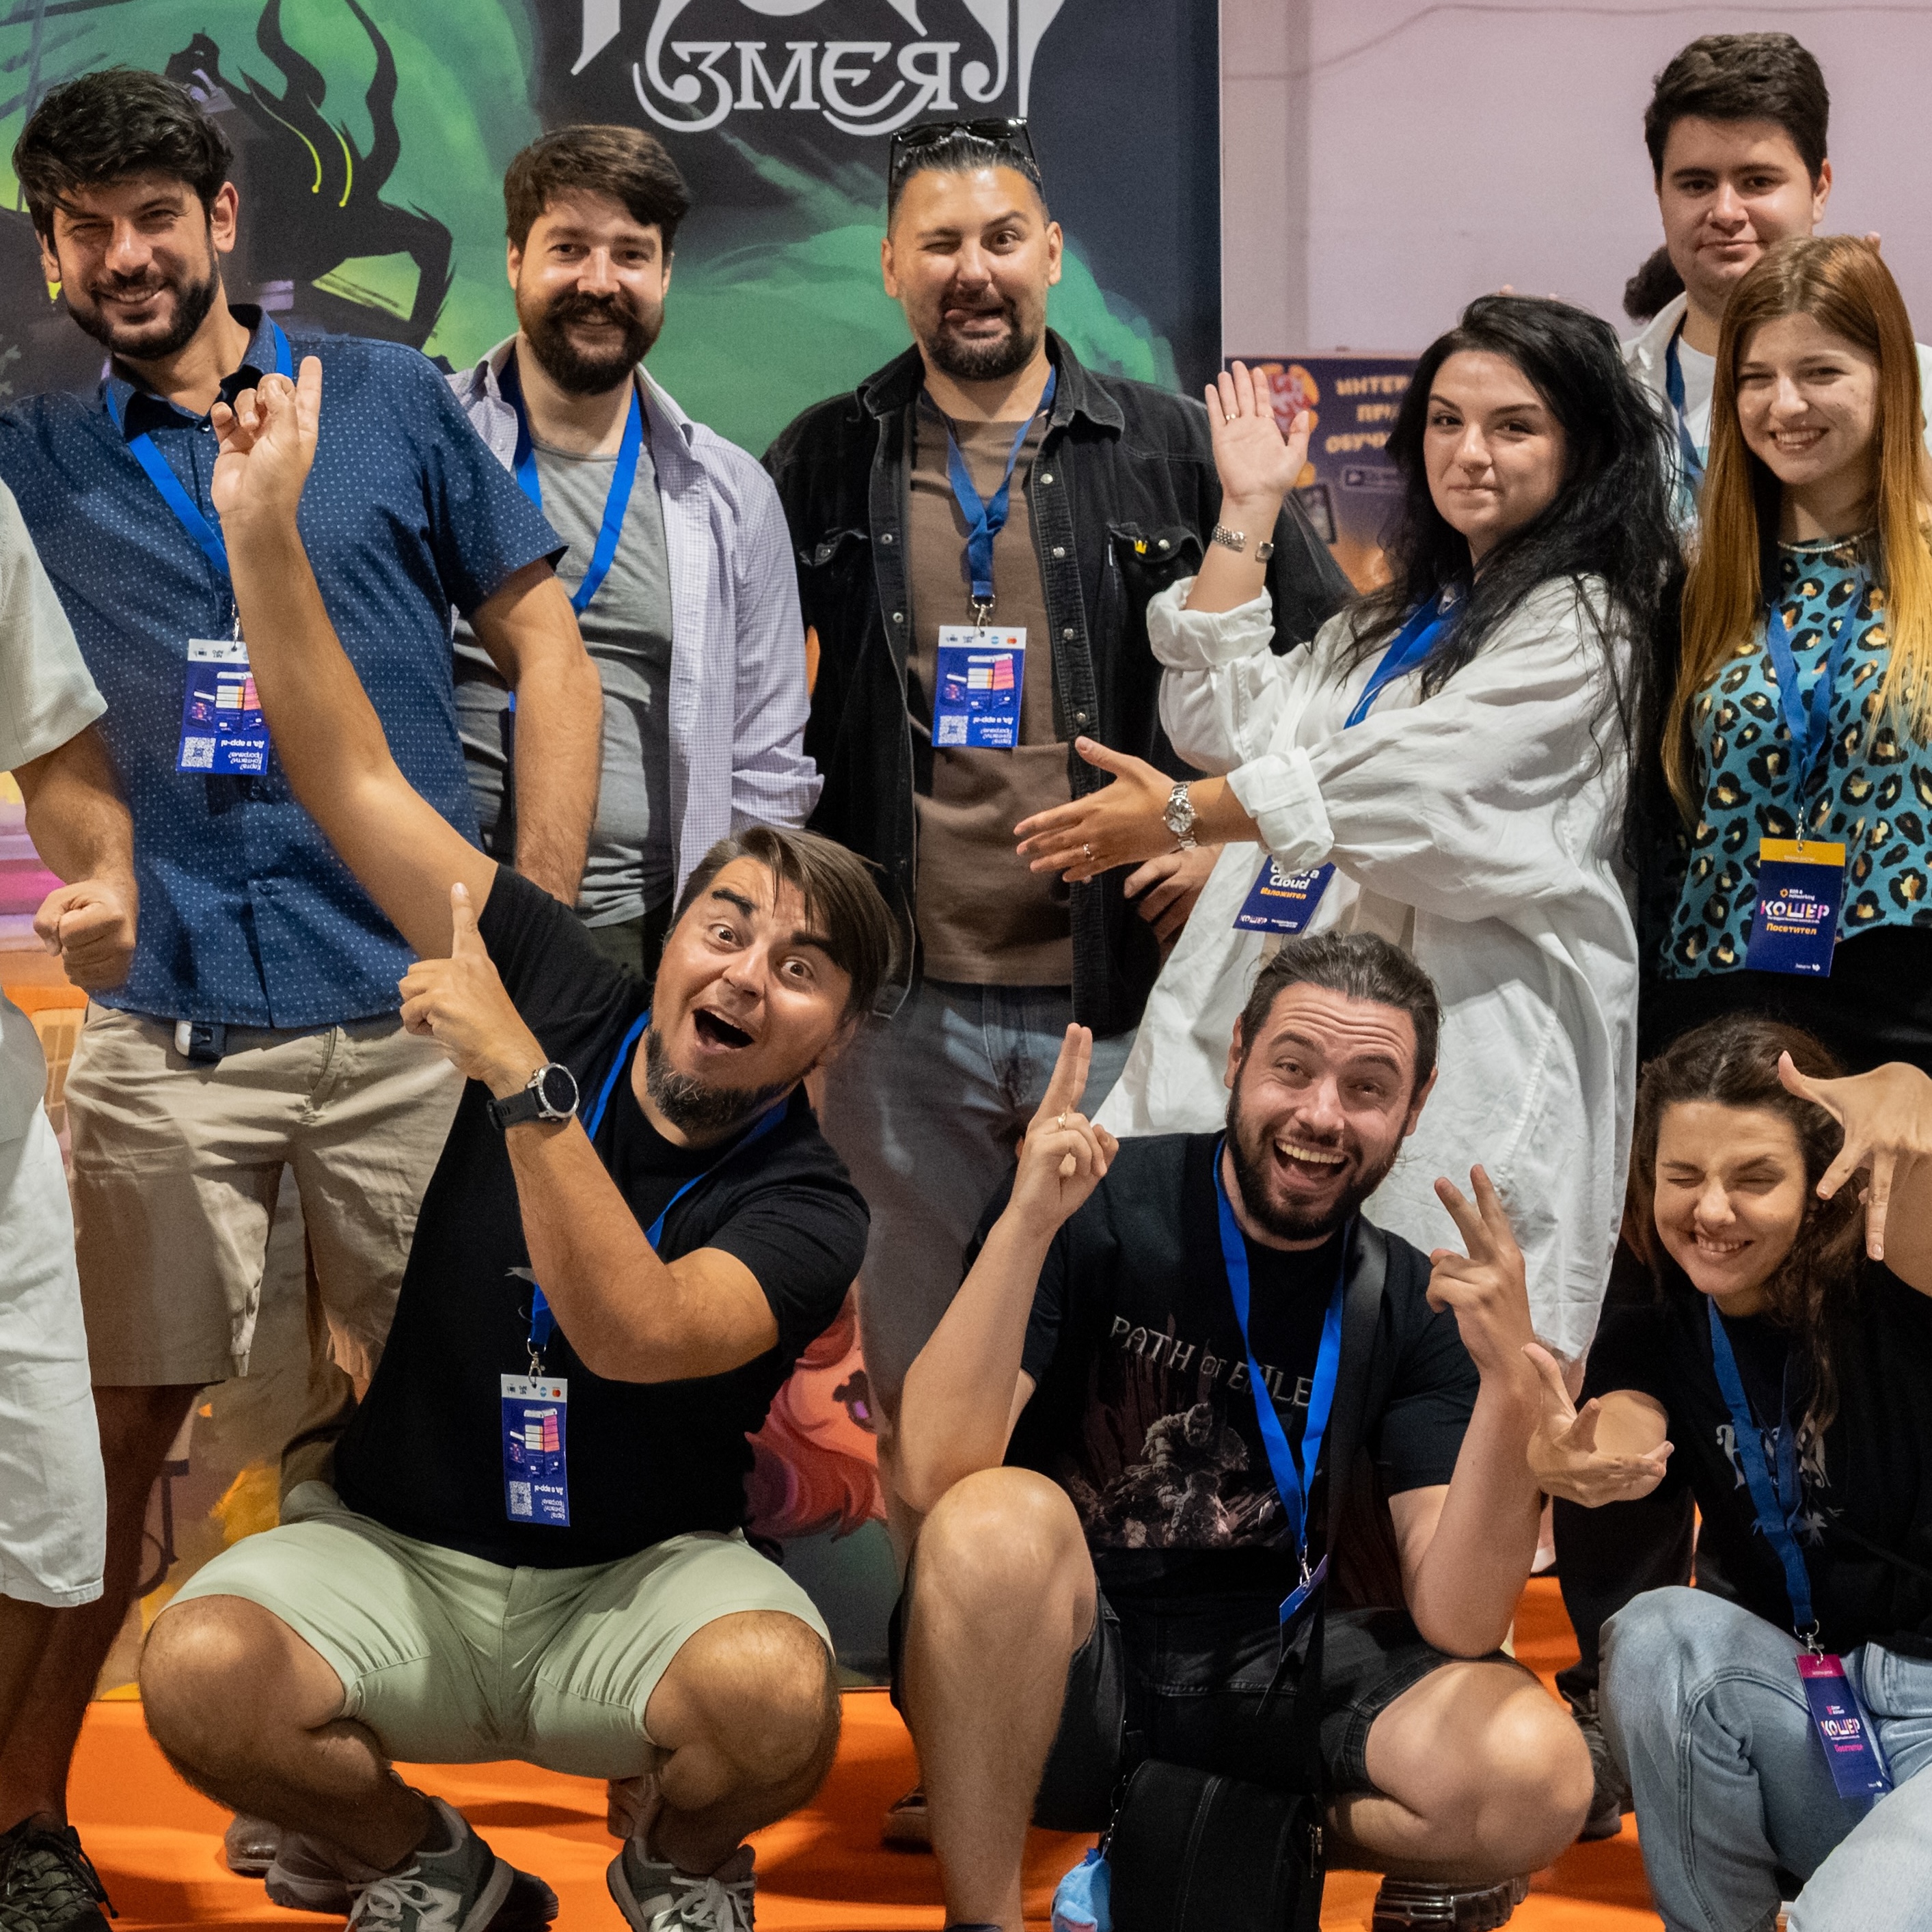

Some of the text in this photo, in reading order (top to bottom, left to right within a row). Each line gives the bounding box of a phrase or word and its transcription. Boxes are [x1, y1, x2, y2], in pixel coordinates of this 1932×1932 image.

[633, 41, 960, 136] ЗМЕЯ
[1269, 874, 1311, 890] Cloud
[1766, 922, 1817, 936] Посетител
[1109, 1315, 1196, 1373] PATH
[1226, 1361, 1314, 1407] EILE
